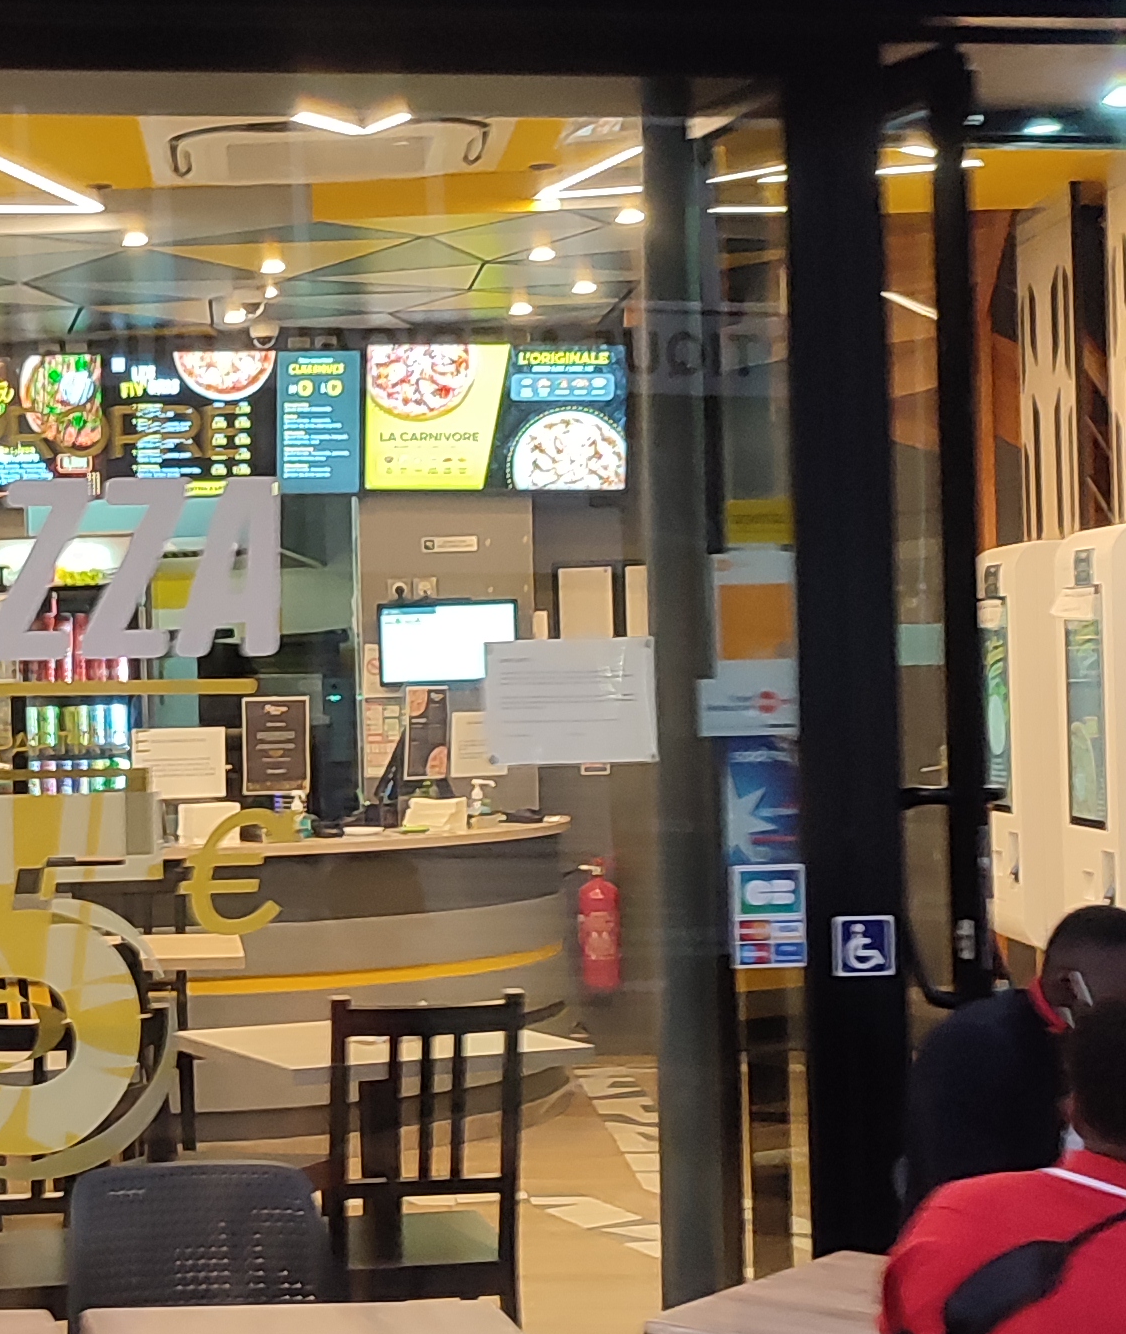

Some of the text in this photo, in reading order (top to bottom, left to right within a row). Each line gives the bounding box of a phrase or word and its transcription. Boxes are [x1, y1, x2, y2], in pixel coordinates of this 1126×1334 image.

[517, 351, 611, 366] L'ORIGINALE
[380, 431, 480, 443] LA CARNIVORE
